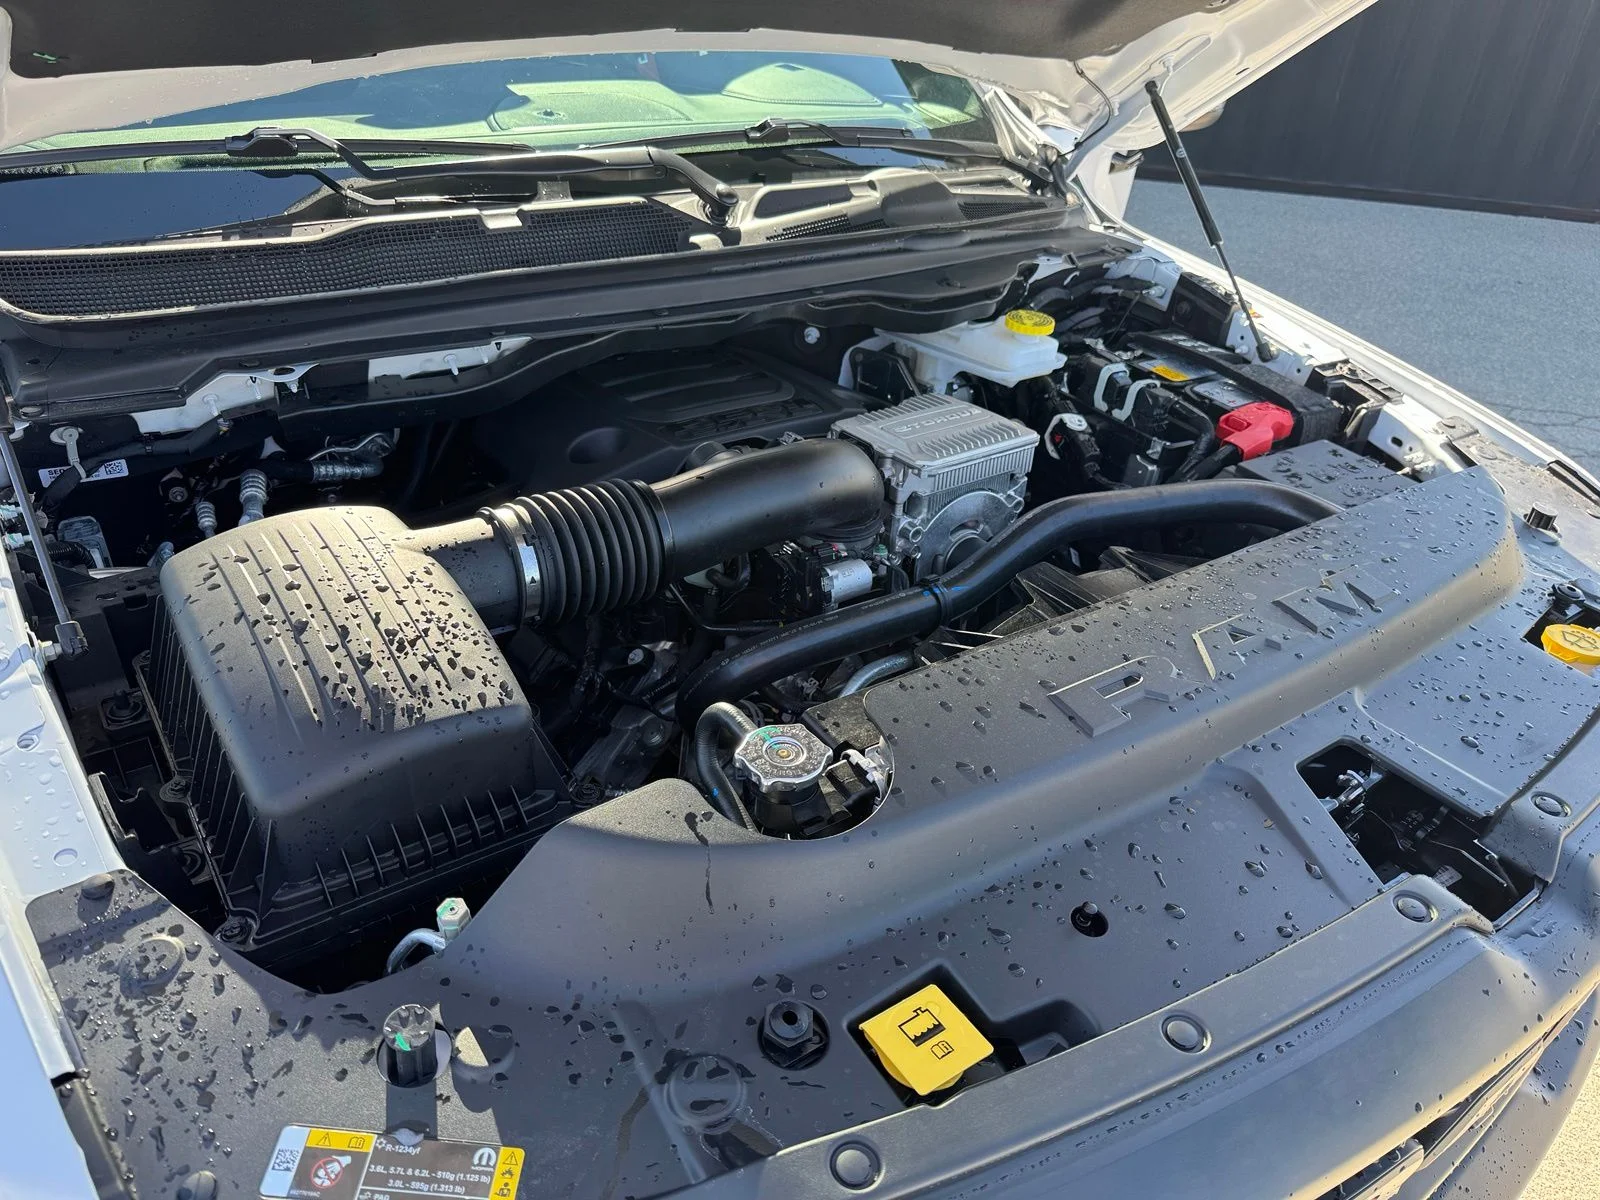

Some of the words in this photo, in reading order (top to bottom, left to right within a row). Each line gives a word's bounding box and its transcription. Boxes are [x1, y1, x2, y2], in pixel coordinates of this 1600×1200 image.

[1047, 564, 1399, 737] RAM
[385, 1143, 421, 1156] R-1234yf
[388, 1166, 405, 1175] 5.7L
[414, 1168, 431, 1178] 6.2L
[436, 1170, 456, 1182] 510g
[456, 1172, 480, 1182] (1.125
[480, 1175, 490, 1185] lb)
[387, 1178, 405, 1188] 3.0L
[410, 1181, 429, 1192] 595g
[454, 1186, 465, 1195] lb)
